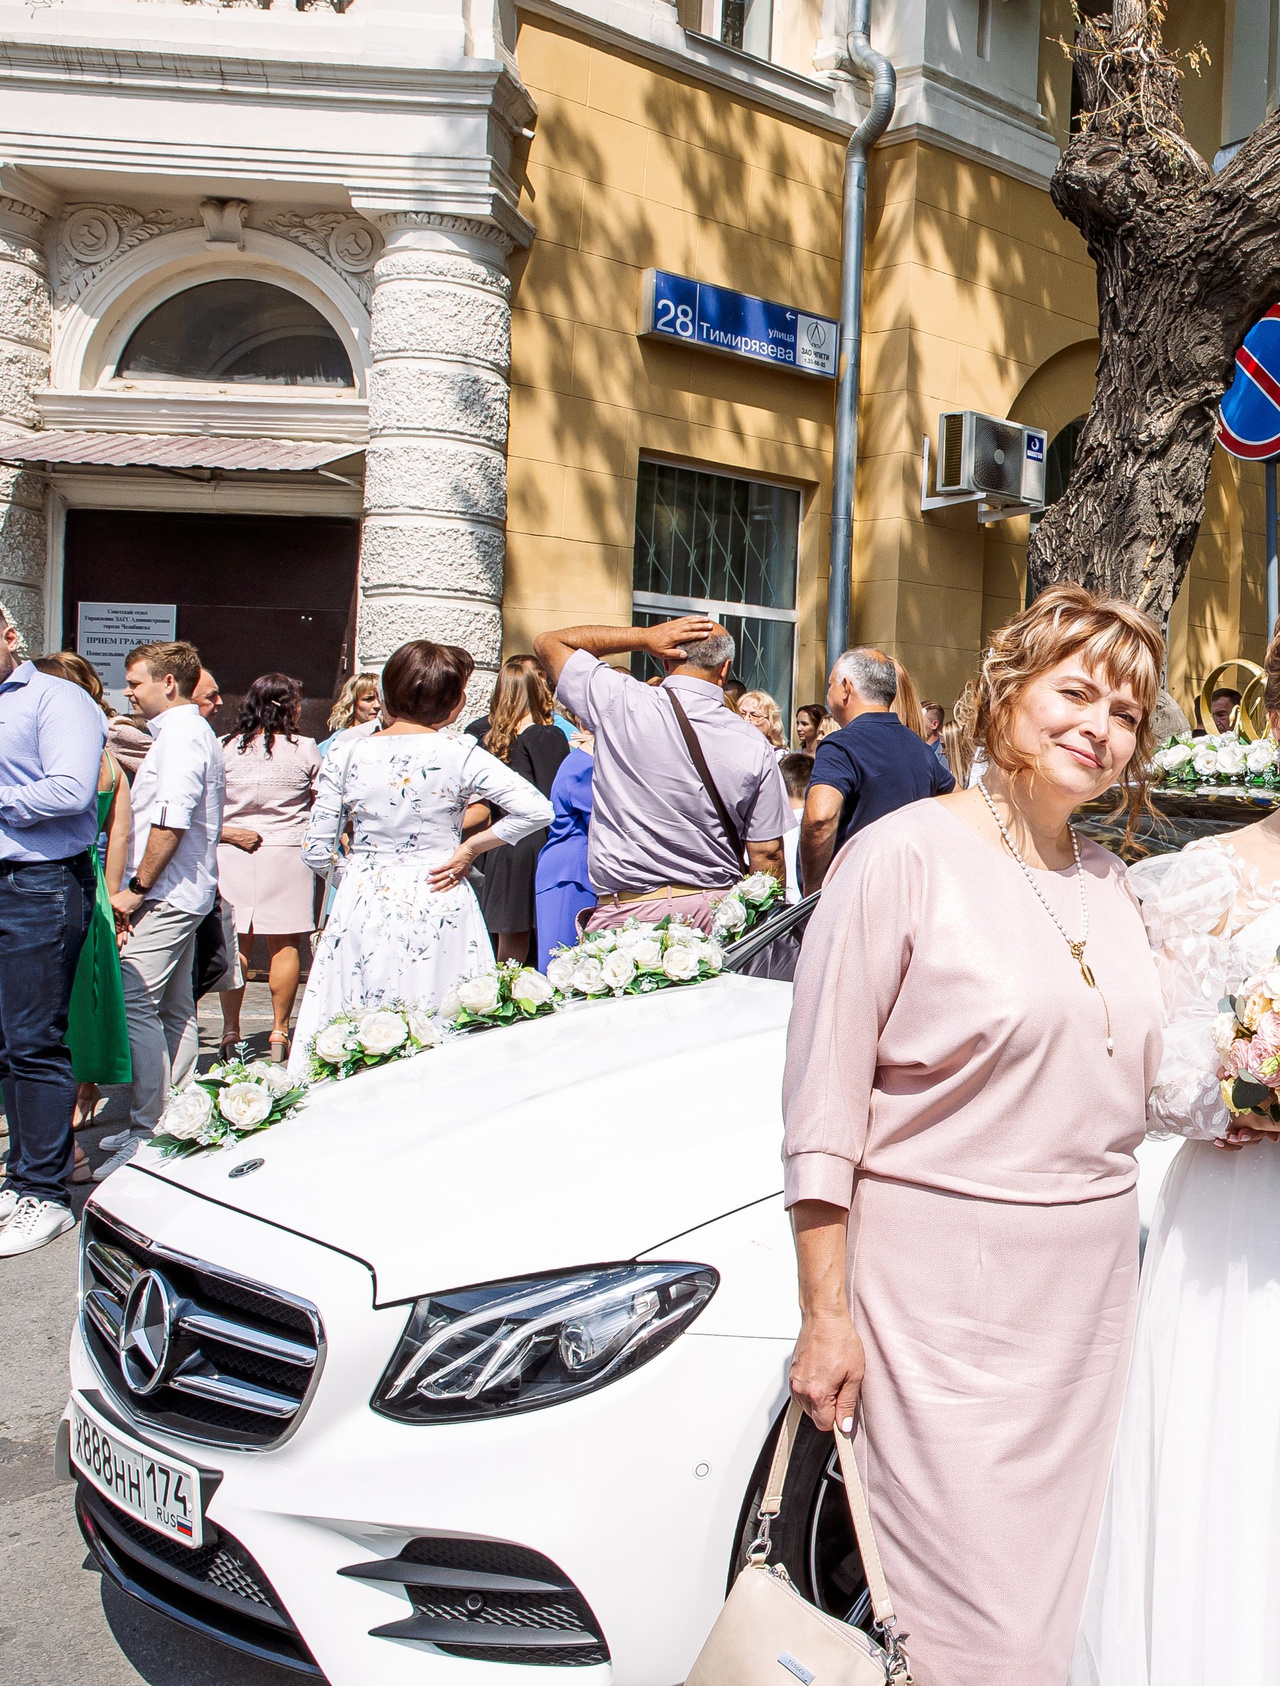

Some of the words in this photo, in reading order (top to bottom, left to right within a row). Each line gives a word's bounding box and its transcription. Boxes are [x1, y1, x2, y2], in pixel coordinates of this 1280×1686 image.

[656, 299, 694, 337] 28
[700, 321, 794, 362] Тимирязева
[768, 327, 795, 343] улица
[801, 347, 812, 357] ЗАО
[86, 636, 117, 645] ПРИЕМ
[146, 1462, 188, 1518] 174
[156, 1506, 177, 1529] RUS
